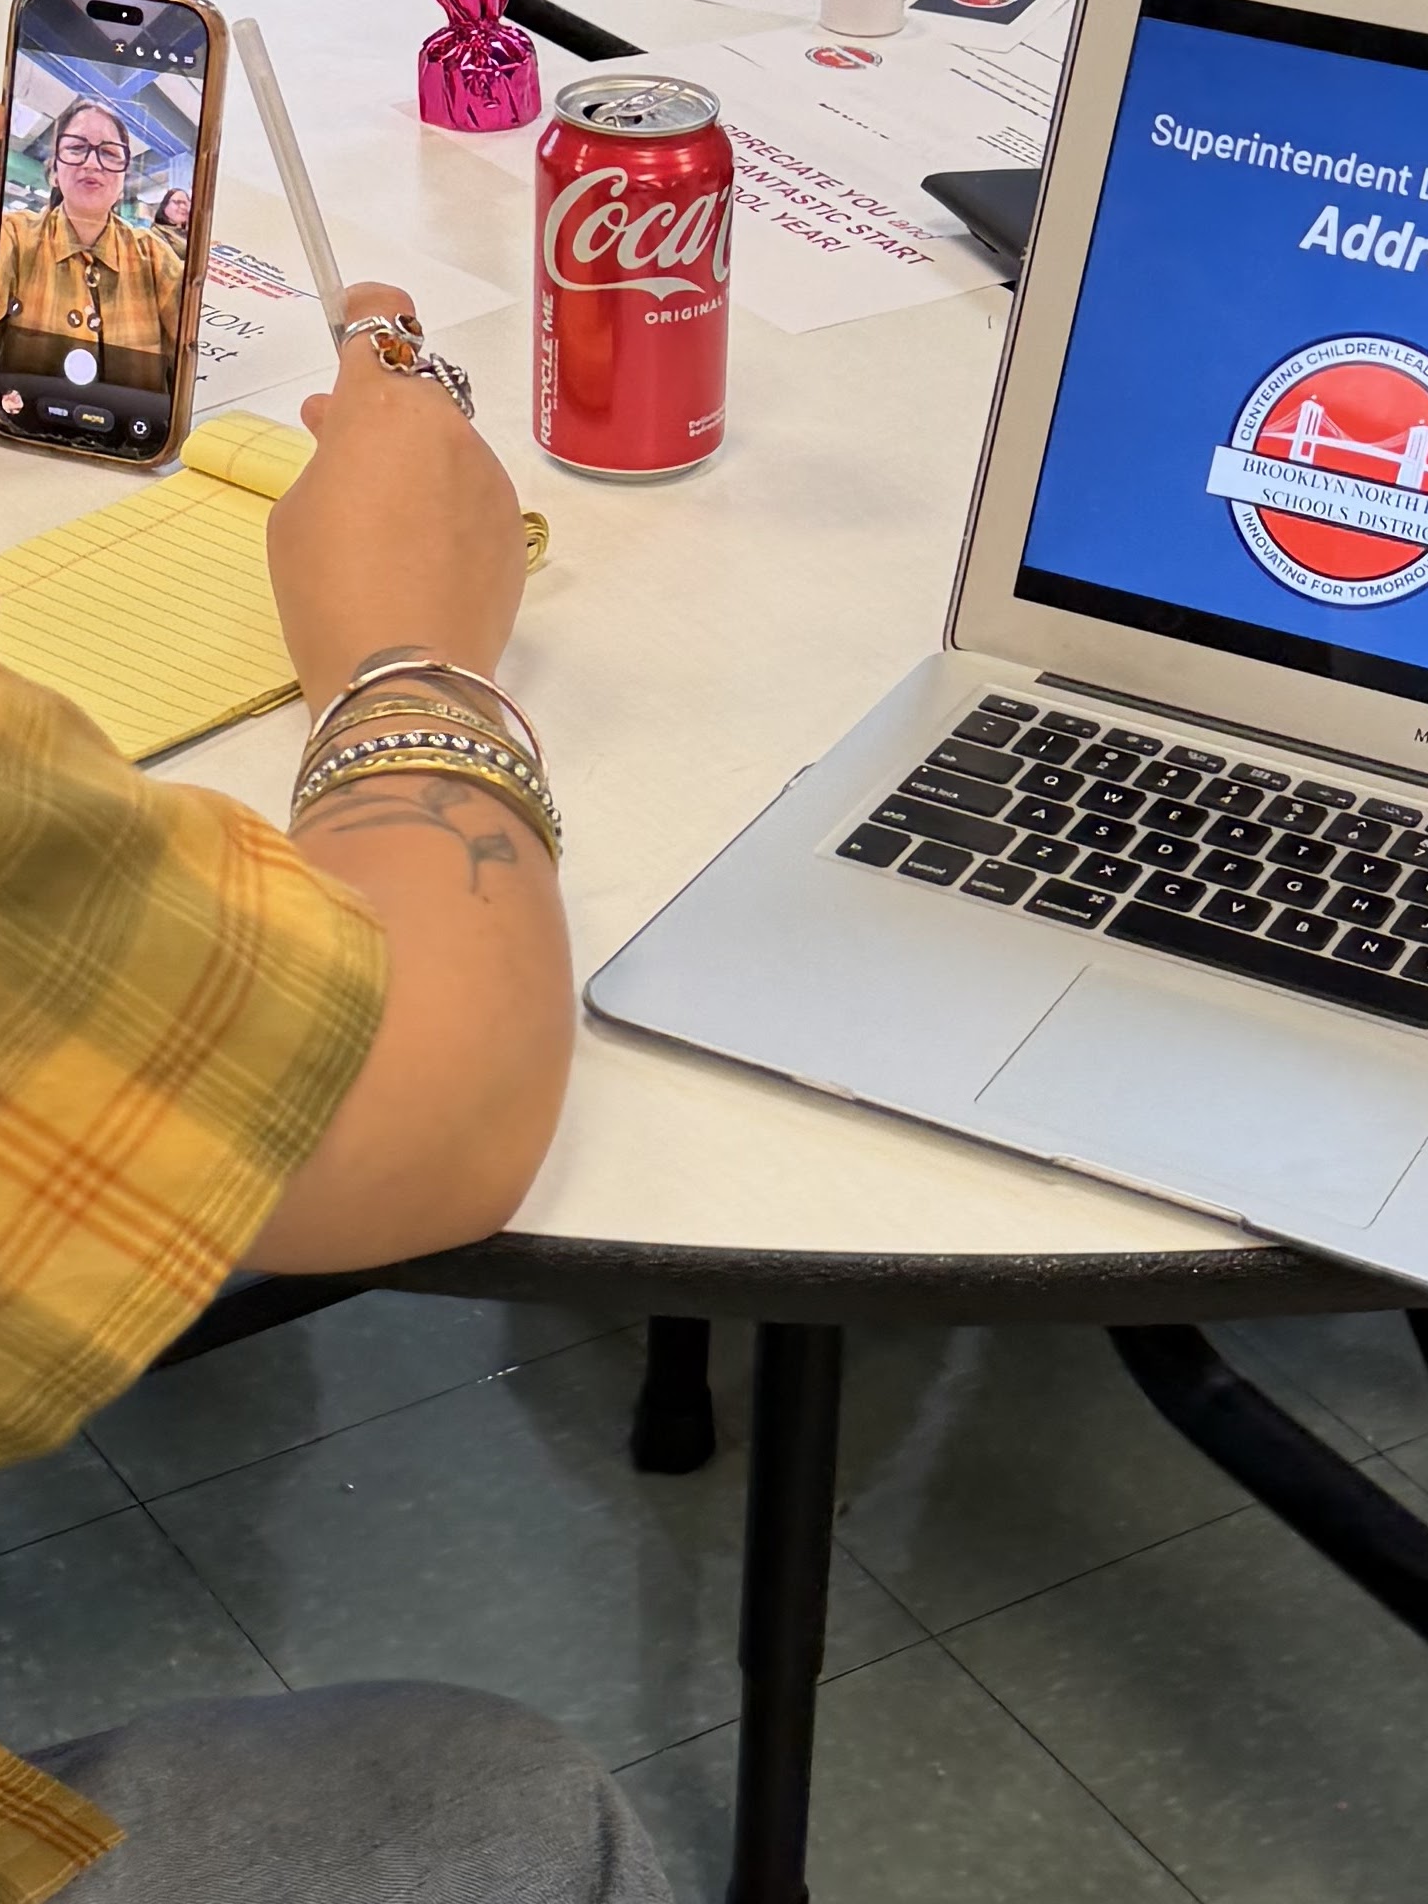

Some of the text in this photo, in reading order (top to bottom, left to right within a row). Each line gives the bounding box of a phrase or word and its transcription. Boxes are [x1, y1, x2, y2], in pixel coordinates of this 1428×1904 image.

[723, 123, 844, 190] PPRECIATE
[837, 188, 897, 217] YOU
[1151, 113, 1412, 196] Superintendent
[846, 223, 935, 265] START
[542, 289, 554, 332] ME
[644, 295, 723, 325] ORIGINAL
[1240, 363, 1303, 441] CENTERING
[1242, 458, 1346, 495] BROOKLYN
[1352, 483, 1420, 512] NORTH
[1260, 488, 1349, 521] SCHOOLS
[1242, 511, 1307, 586] INNOVATING
[1310, 579, 1343, 597] FOR
